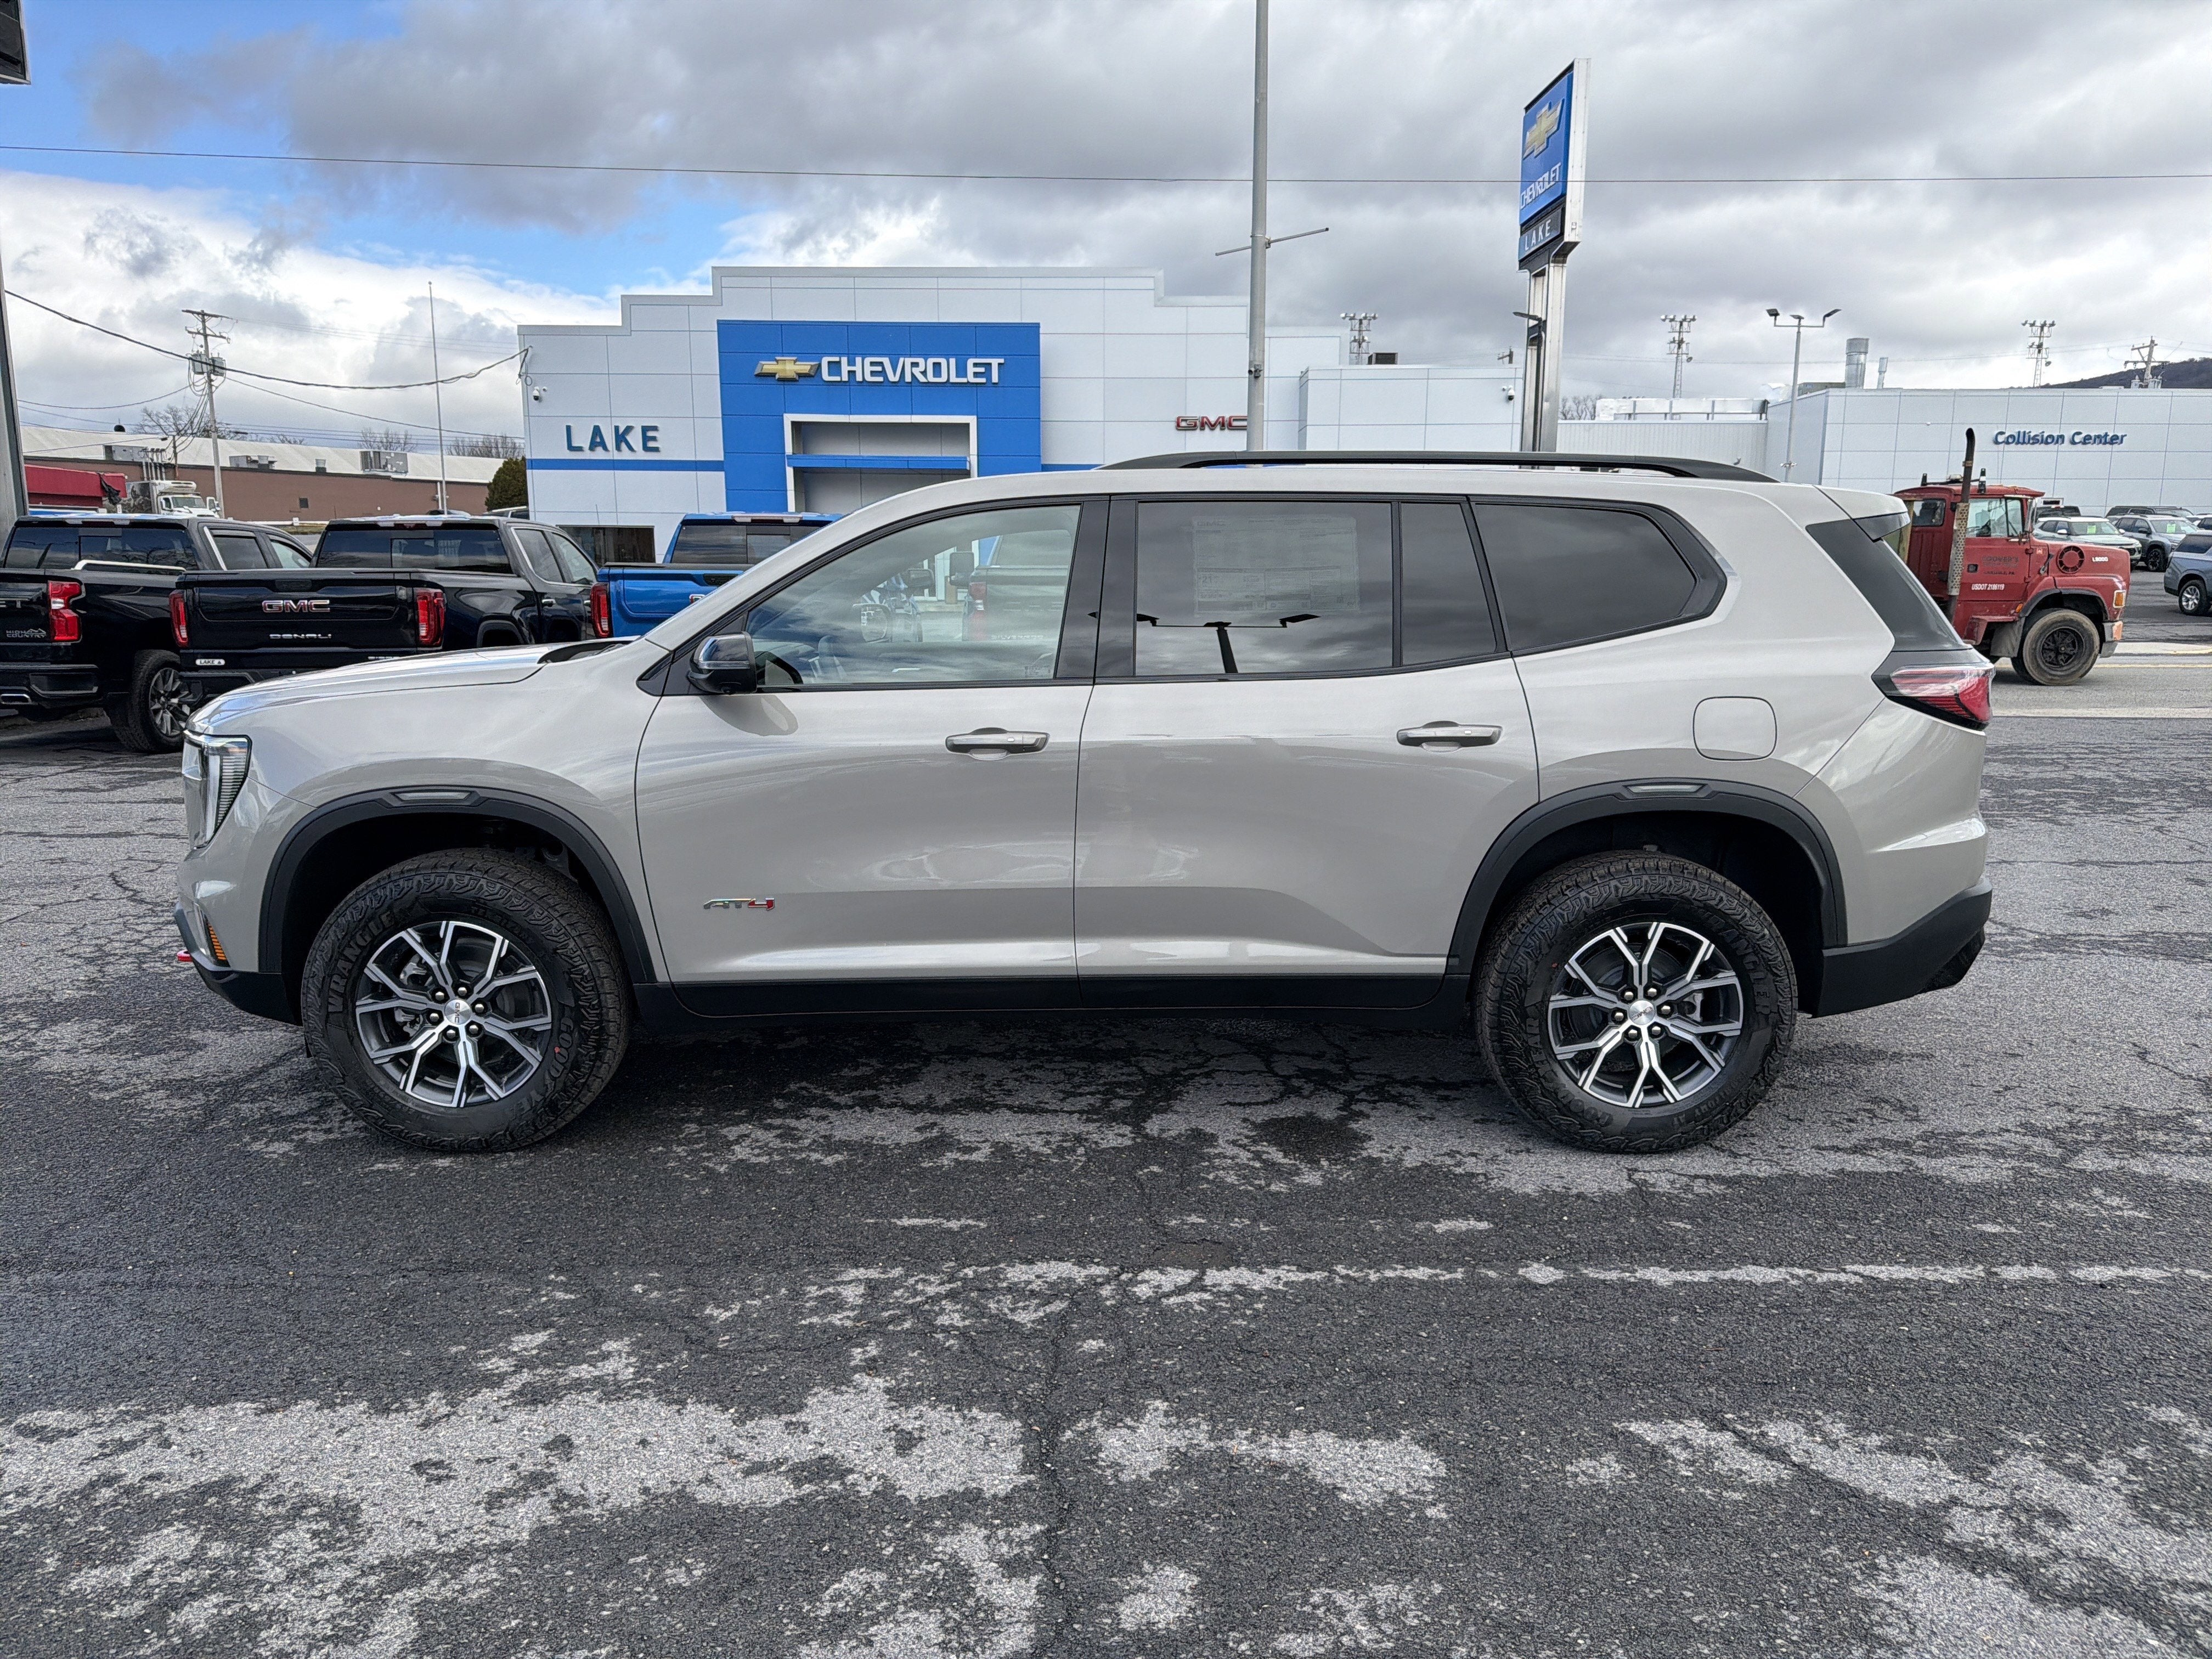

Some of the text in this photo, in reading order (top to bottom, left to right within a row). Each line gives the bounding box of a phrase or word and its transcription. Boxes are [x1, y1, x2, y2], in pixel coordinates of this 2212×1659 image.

[1520, 162, 1561, 210] CHEVROLET
[1525, 219, 1551, 251] LAKE
[821, 357, 1005, 383] CHEVROLET
[1176, 416, 1248, 430] GMC
[566, 425, 660, 452] LAKE
[1994, 431, 2127, 445] Collision Center
[262, 600, 330, 613] GMC
[703, 898, 775, 911] AT4
[1631, 1006, 1652, 1021] GMC
